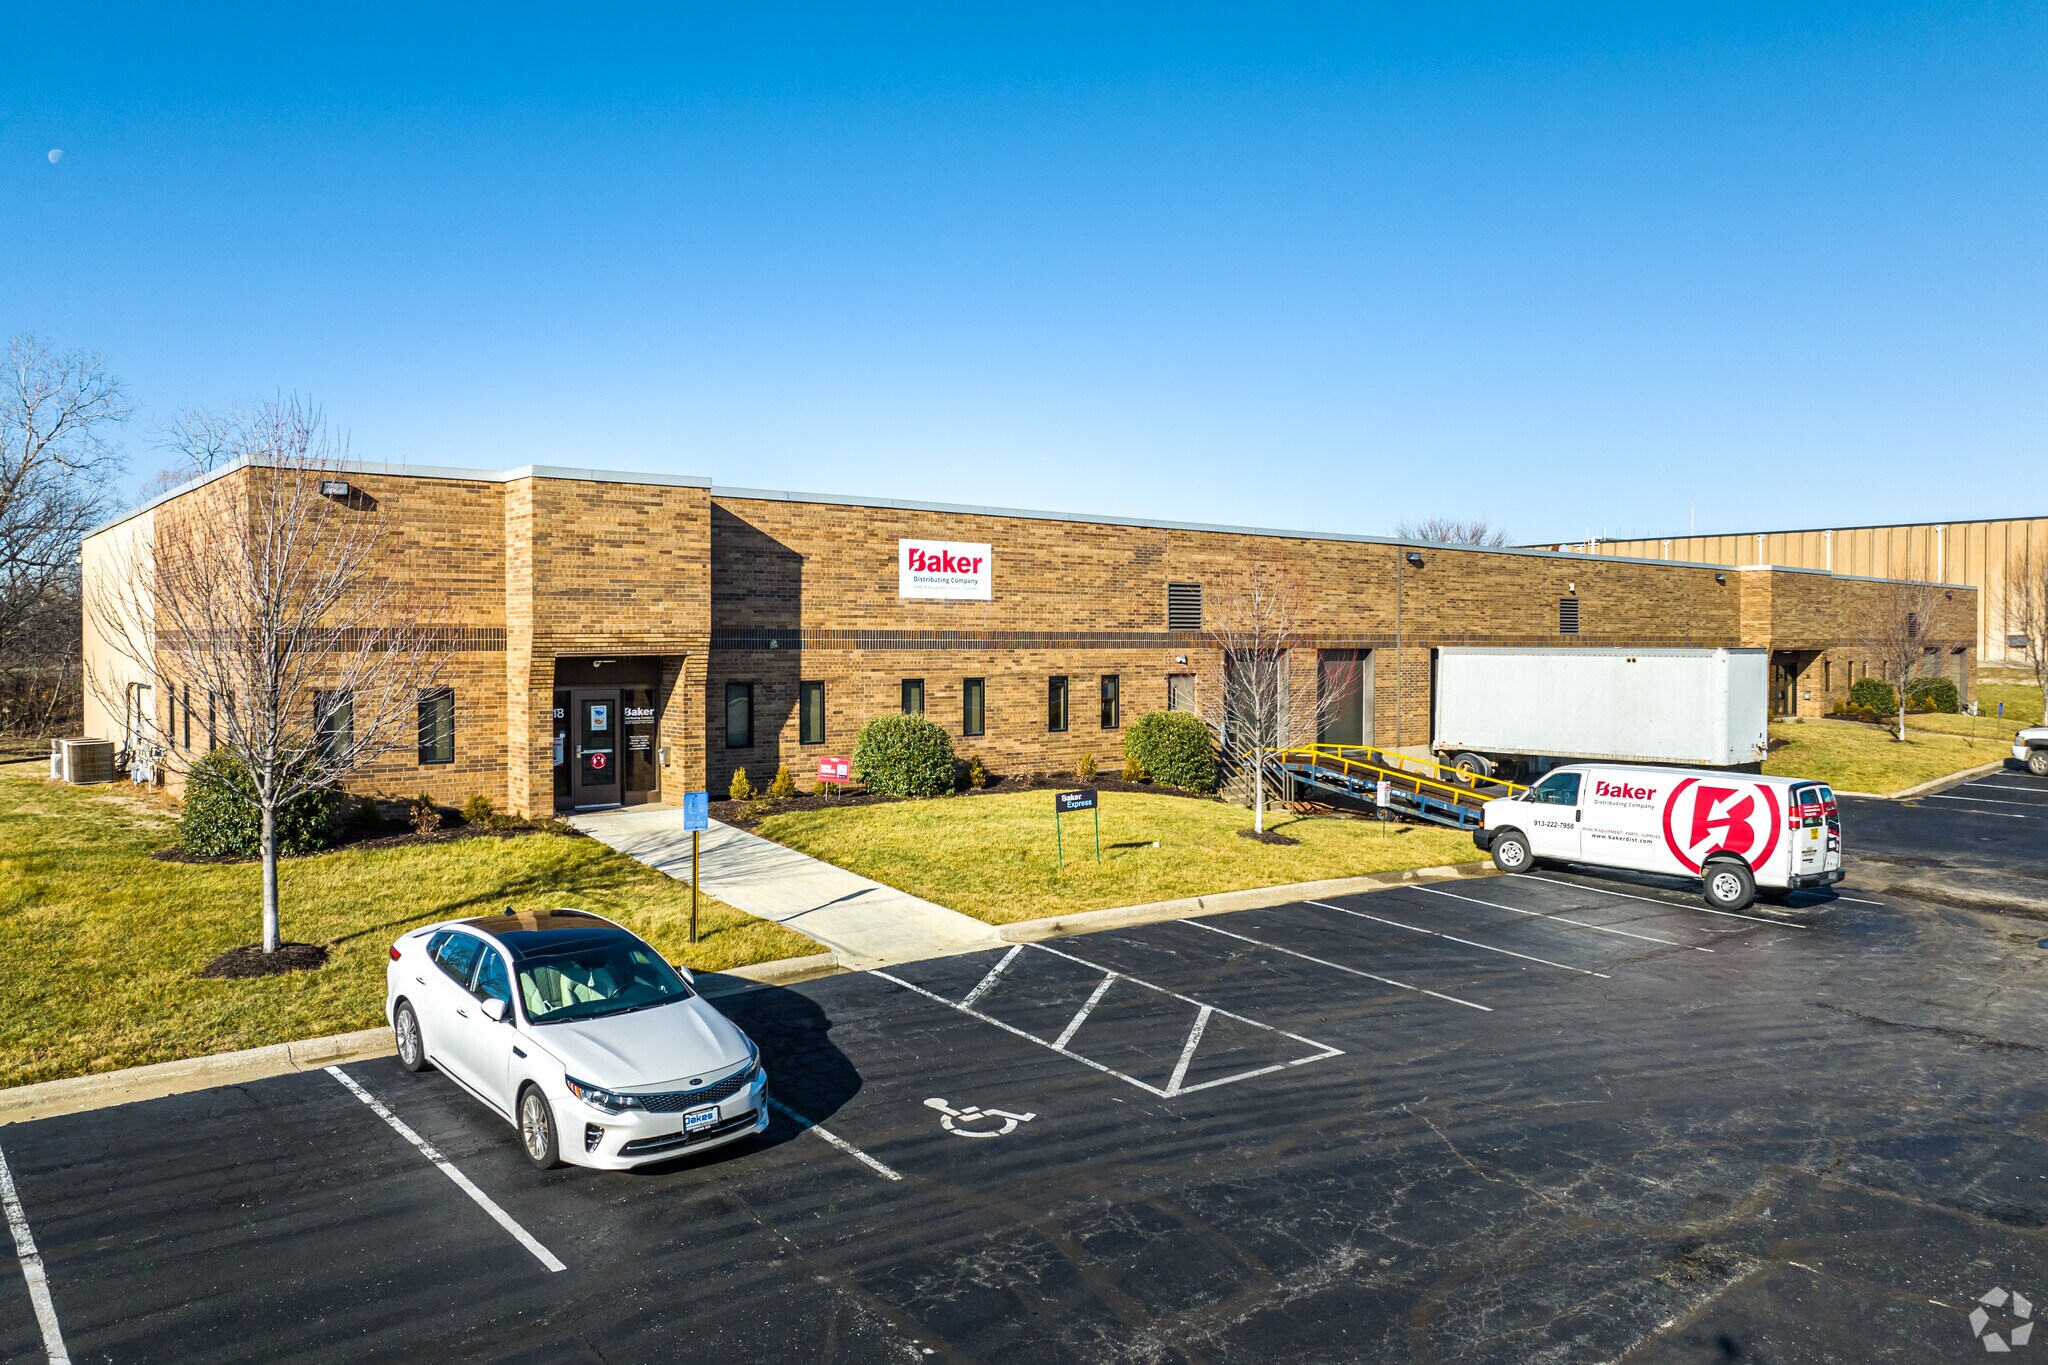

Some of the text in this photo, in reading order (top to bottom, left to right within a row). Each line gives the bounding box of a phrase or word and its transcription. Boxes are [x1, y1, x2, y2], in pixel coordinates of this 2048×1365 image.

[909, 548, 983, 574] Baker
[913, 576, 979, 586] Distributing Company
[625, 707, 655, 716] Baker
[1596, 781, 1657, 801] Baker
[1061, 794, 1082, 802] Baker
[1067, 800, 1092, 809] Express
[1594, 800, 1655, 810] Distributing Company
[1533, 819, 1575, 829] 913-222-7958
[1591, 834, 1653, 844] www.bakerdist.com
